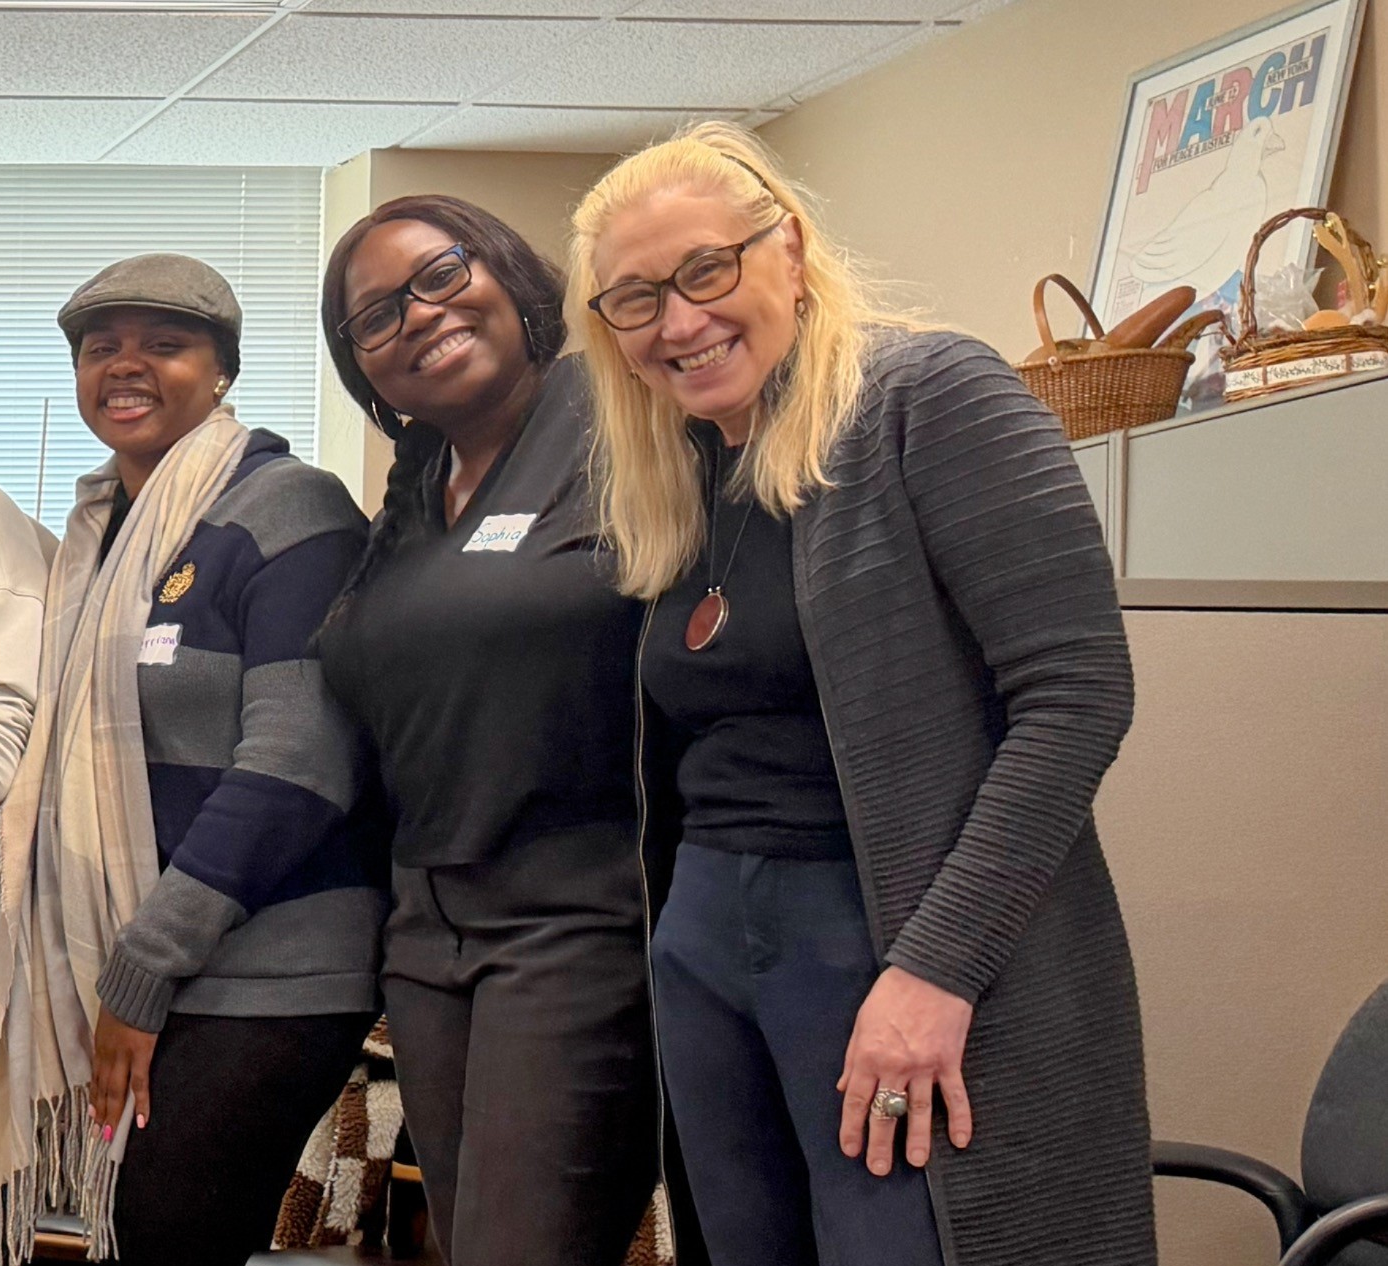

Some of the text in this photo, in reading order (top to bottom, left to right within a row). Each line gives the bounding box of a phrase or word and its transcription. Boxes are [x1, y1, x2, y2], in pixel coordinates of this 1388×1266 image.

[1266, 60, 1309, 85] NEW YORK
[1136, 34, 1326, 195] MARCH
[1153, 155, 1168, 170] FOR
[1169, 145, 1193, 164] PEACE
[1201, 132, 1231, 153] JUSTICE
[471, 523, 522, 548] Sophia
